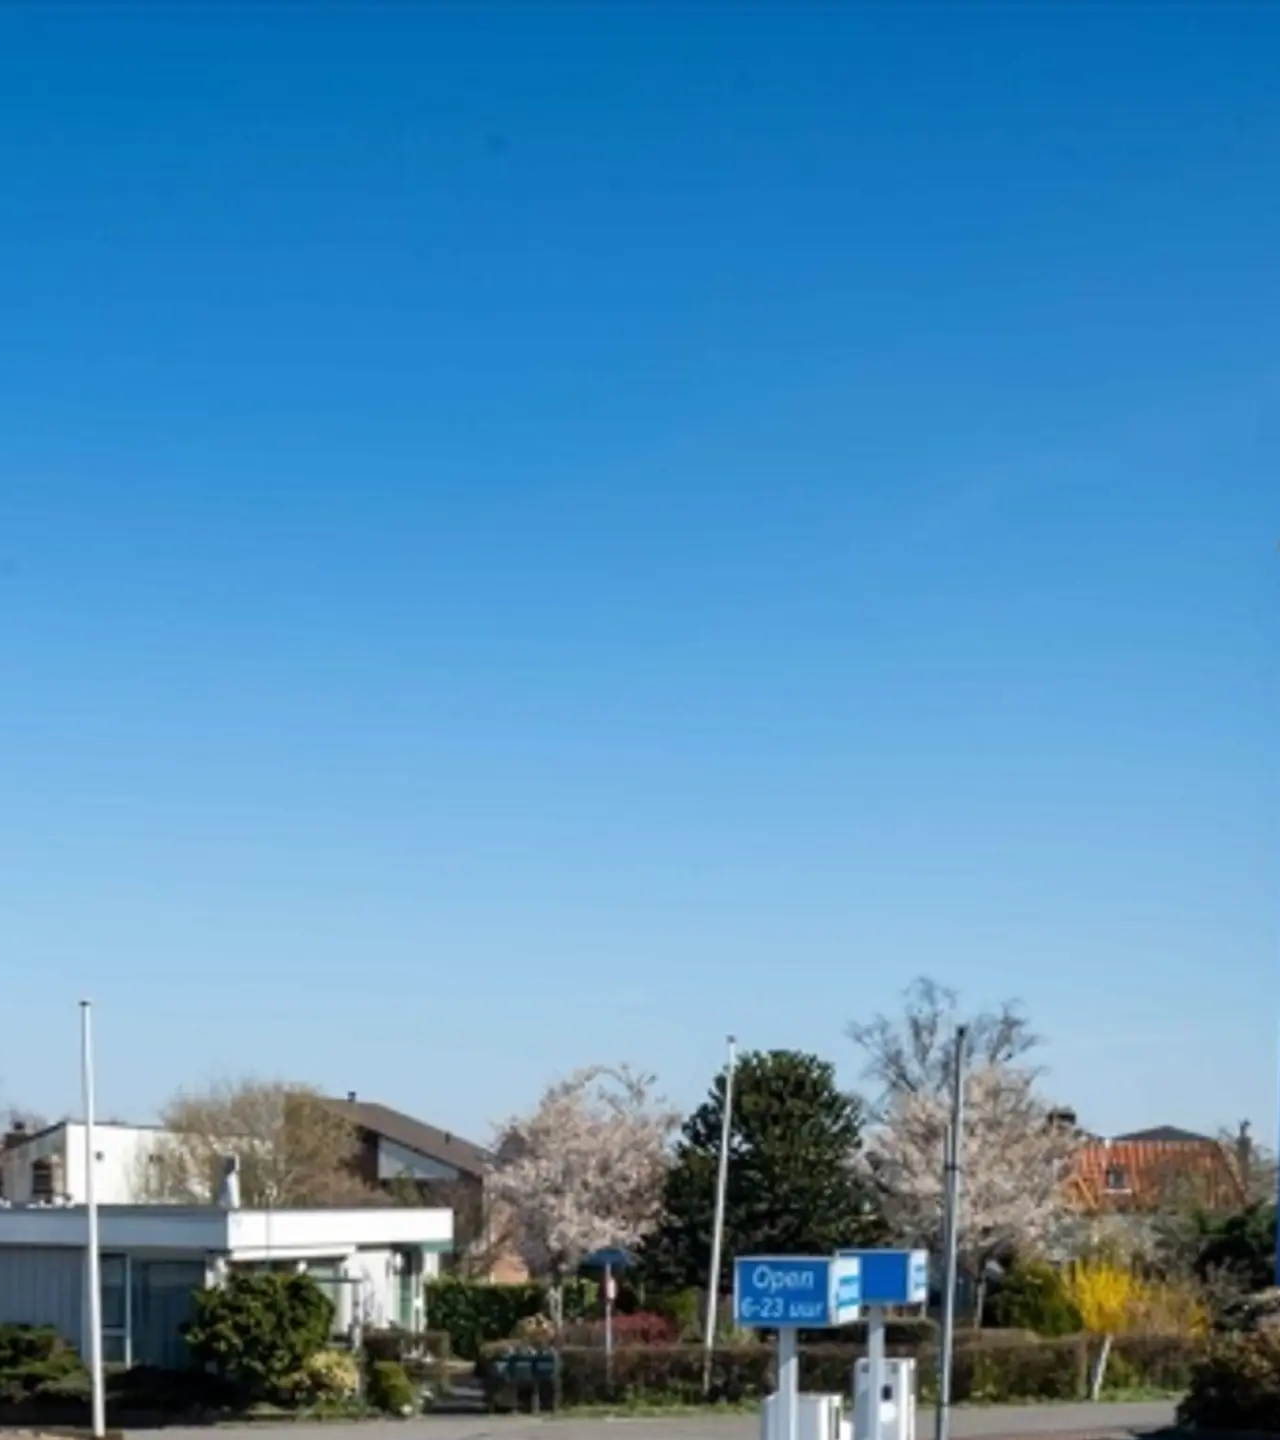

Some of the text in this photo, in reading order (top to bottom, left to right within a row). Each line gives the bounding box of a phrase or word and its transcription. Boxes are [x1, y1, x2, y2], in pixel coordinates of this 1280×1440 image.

[751, 1264, 815, 1291] Open
[740, 1297, 825, 1318] 6-23 uur
